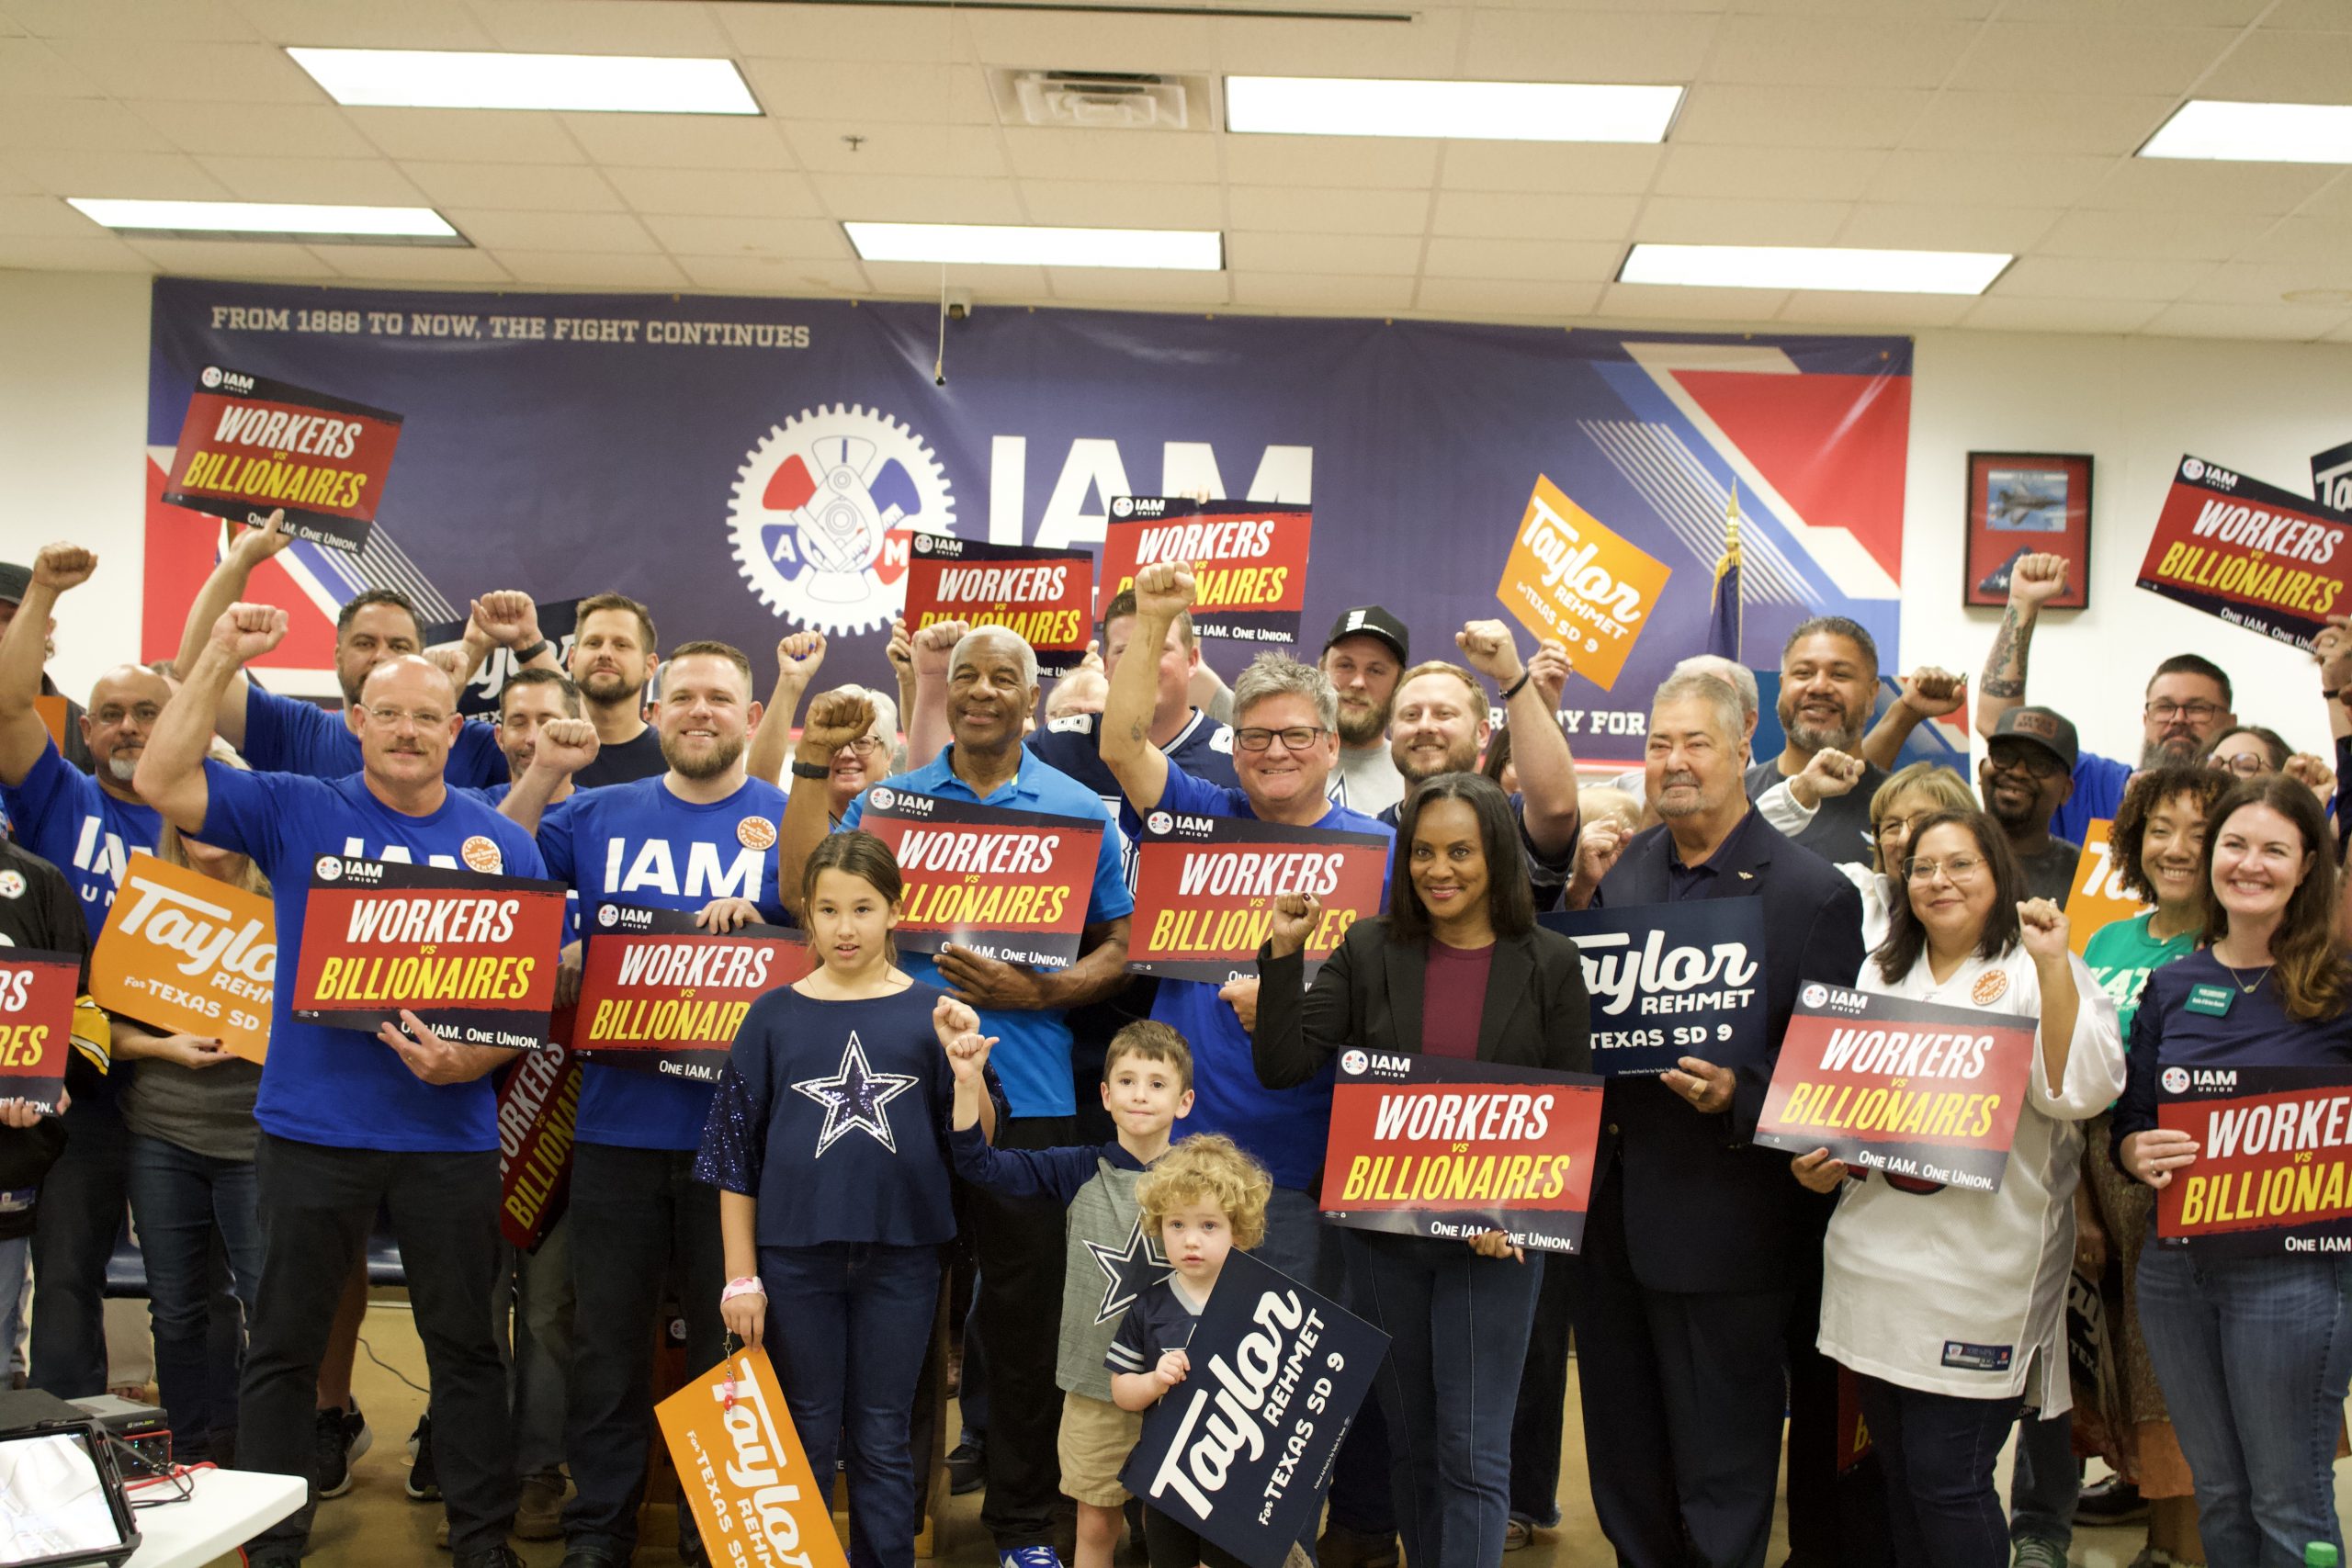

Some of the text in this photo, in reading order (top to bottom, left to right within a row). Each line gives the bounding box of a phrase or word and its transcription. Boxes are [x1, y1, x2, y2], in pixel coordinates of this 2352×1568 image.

[211, 306, 810, 348] FROM 1888 TO NOW, THE FIGHT CONTINUES
[222, 371, 254, 390] IAM
[213, 405, 363, 459] WORKERS
[182, 451, 368, 509] BILLIONAIRES
[2206, 466, 2238, 488] IAM
[1135, 499, 1165, 512] IAM
[278, 520, 297, 536] AM.
[300, 526, 322, 542] ONE
[323, 533, 358, 552] UNION.
[772, 534, 797, 562] A
[884, 538, 909, 567] M
[934, 537, 963, 553] IAM
[1136, 520, 1274, 565] WORKERS
[2192, 499, 2345, 565] WORKERS
[1521, 495, 1641, 624] Taylor
[2156, 540, 2344, 615] BILLIONAIRES
[935, 566, 1068, 603] WORKERS
[1525, 585, 1557, 626] TEXAS
[1556, 619, 1581, 641] SD
[1584, 638, 1599, 653] 9
[1554, 584, 1629, 640] REHMET
[2221, 607, 2243, 625] ONE
[2244, 615, 2268, 636] IAM.
[2271, 626, 2294, 644] ONE
[1204, 625, 1229, 637] IAM.
[1232, 626, 1255, 640] ONE
[1257, 628, 1294, 643] UNION.
[1589, 710, 1646, 735] FOR
[897, 793, 934, 812] IAM
[899, 807, 929, 817] UNION
[1176, 815, 1214, 832] IAM
[1179, 829, 1209, 839] UNION
[73, 815, 153, 888] IA
[345, 861, 383, 878] IAM
[604, 837, 766, 902] IAM
[896, 829, 1060, 874] WORKERS
[1178, 852, 1345, 897] WORKERS
[345, 899, 520, 943] WORKERS
[620, 908, 652, 924] IAM
[898, 882, 1070, 924] LLIONAIRES
[118, 875, 277, 982] Taylo
[314, 956, 536, 999] BILLIONAIRES
[617, 943, 775, 988] WORKERS
[1001, 947, 1026, 963] ONE
[1028, 951, 1069, 967] UNION.
[124, 975, 147, 989] For
[147, 979, 222, 1020] TEXAS
[227, 1010, 260, 1032] SD
[588, 999, 751, 1042] BILLIONAIR
[1641, 989, 1755, 1016] REHMET
[1830, 991, 1869, 1010] IAM
[1832, 1005, 1861, 1015] UNION
[466, 1027, 494, 1043] ONE
[496, 1032, 541, 1049] UNION.
[1589, 1023, 1733, 1050] TEXAS SD 9
[1819, 1028, 1995, 1079] WORKERS
[659, 1059, 683, 1076] ONE
[684, 1063, 713, 1080] IAM.
[1371, 1055, 1411, 1073] IAM
[1374, 1069, 1406, 1078] UNION
[2193, 1070, 2237, 1086] IAM
[1374, 1094, 1555, 1141] WORKERS
[1779, 1081, 2001, 1138] BILLIONAIRES
[2207, 1097, 2352, 1159] WORKE
[1341, 1155, 1571, 1201] BILLIONAIRES
[1859, 1150, 1994, 1191] ONE IAM. ONE UNION.
[1430, 1221, 1574, 1251] ONE IAM NE UNION.
[2285, 1236, 2316, 1252] ONE
[1262, 1307, 1325, 1427] REHMET
[1149, 1289, 1303, 1520] Taylor
[1258, 1352, 1345, 1526] For TEXAS SD 9
[686, 1429, 701, 1452] For
[695, 1450, 733, 1533] TEXAS
